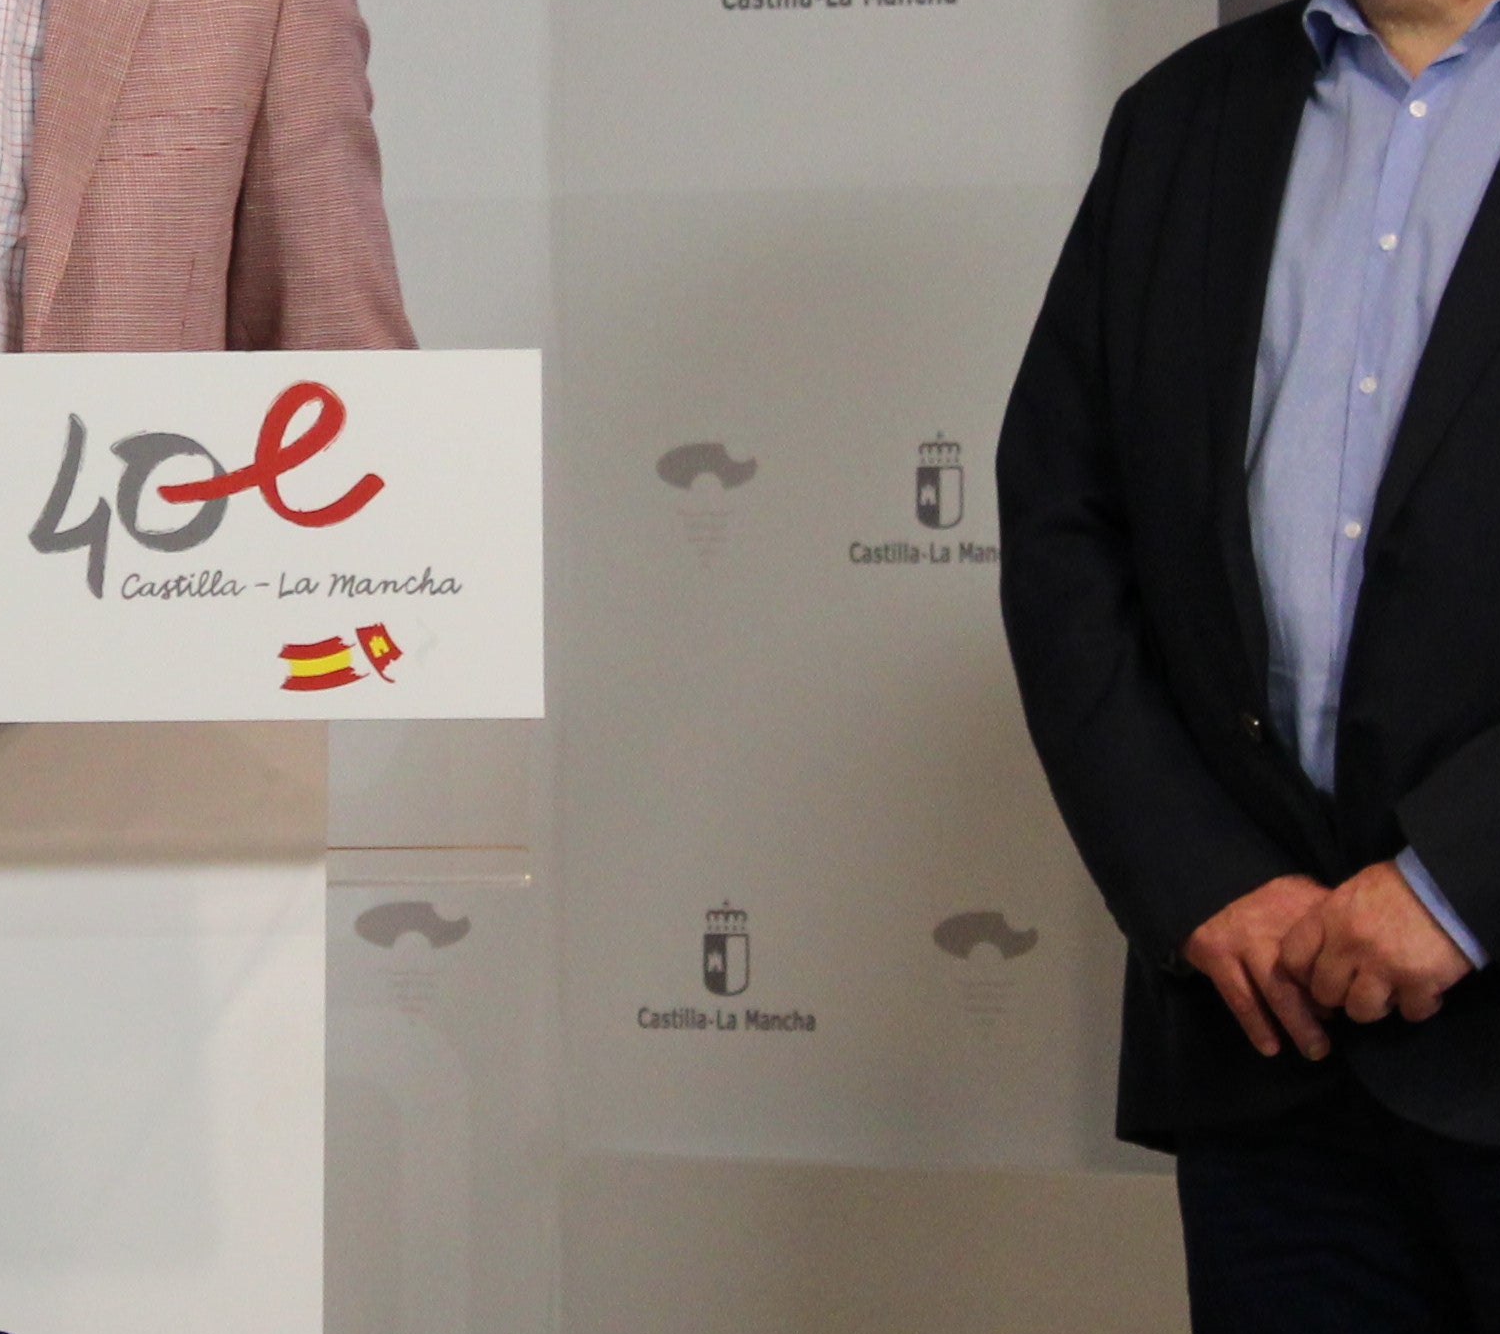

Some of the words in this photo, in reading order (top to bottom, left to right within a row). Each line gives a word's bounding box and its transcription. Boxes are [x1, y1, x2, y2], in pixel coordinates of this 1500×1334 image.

[958, 542, 999, 565] Man
[327, 566, 462, 599] Mancha
[744, 1009, 818, 1033] Mancha
